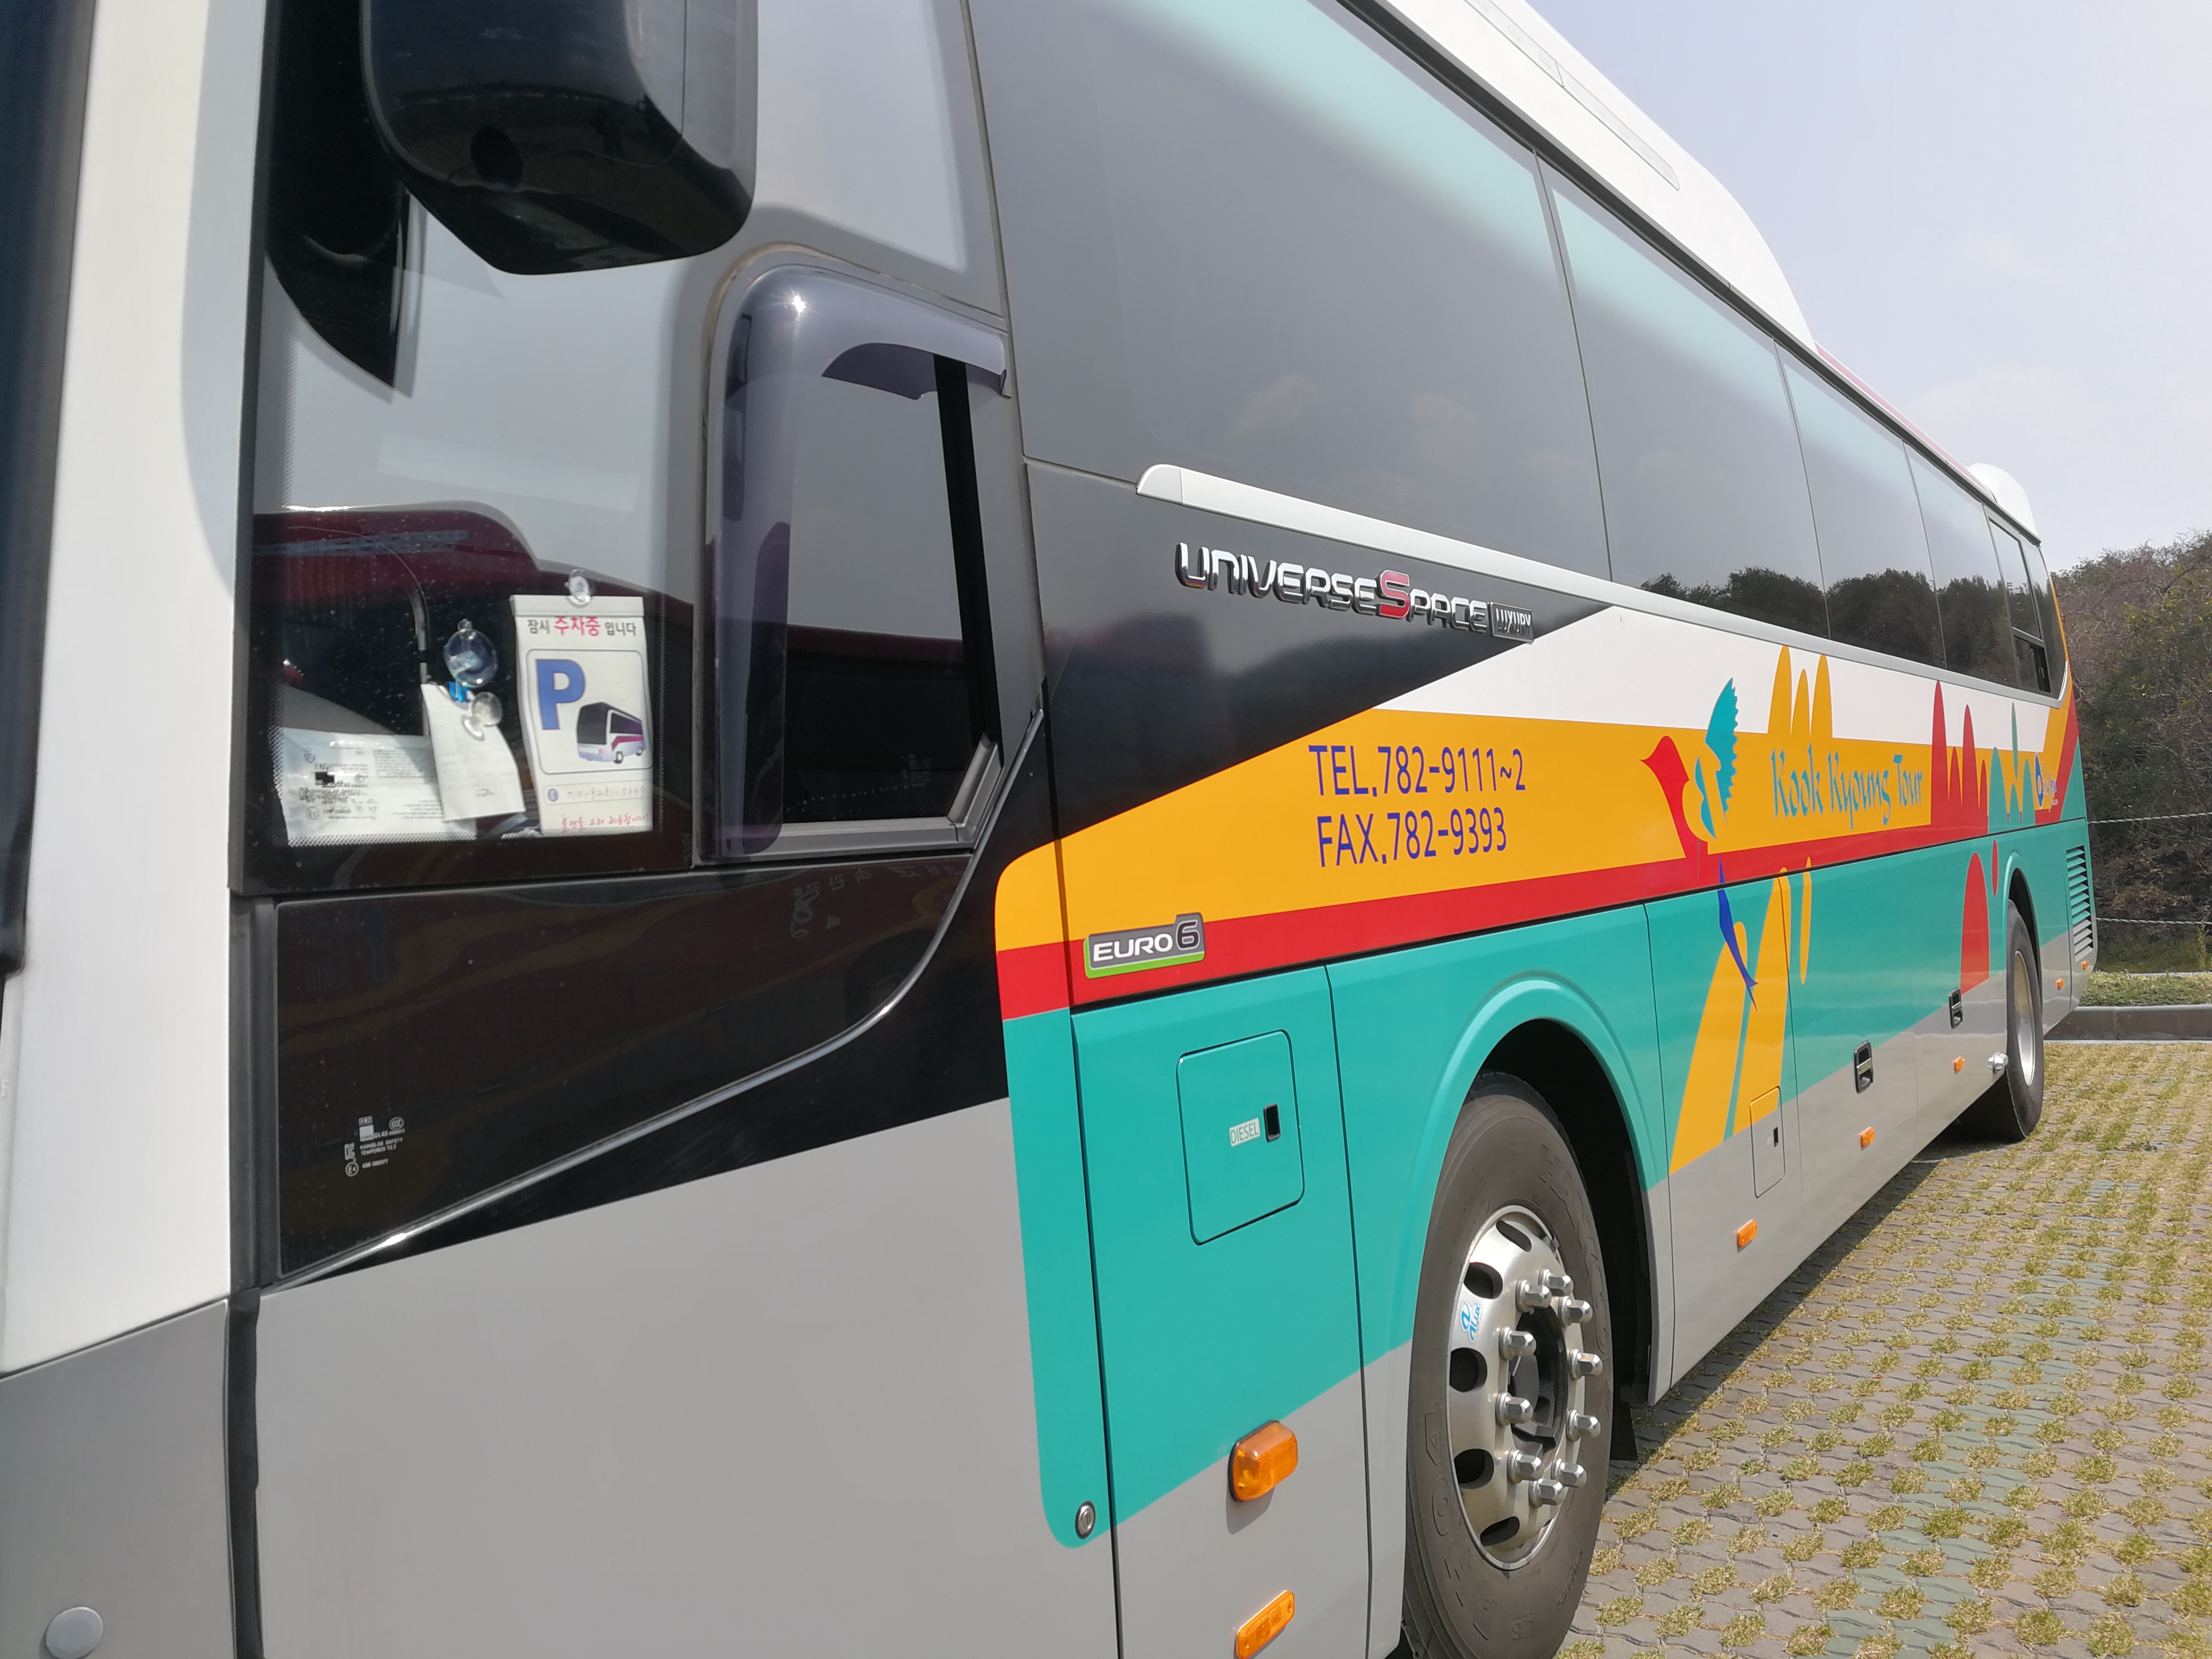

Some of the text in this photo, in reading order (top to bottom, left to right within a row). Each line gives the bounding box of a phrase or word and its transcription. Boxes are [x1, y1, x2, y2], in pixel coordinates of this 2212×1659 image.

[527, 615, 637, 636] 잠시 주차중 입니다
[535, 658, 586, 730] P
[1770, 743, 1824, 819] Kook
[1893, 754, 1923, 808] Tour
[1093, 919, 1200, 962] EURO 6
[1230, 1122, 1259, 1144] DIESEL
